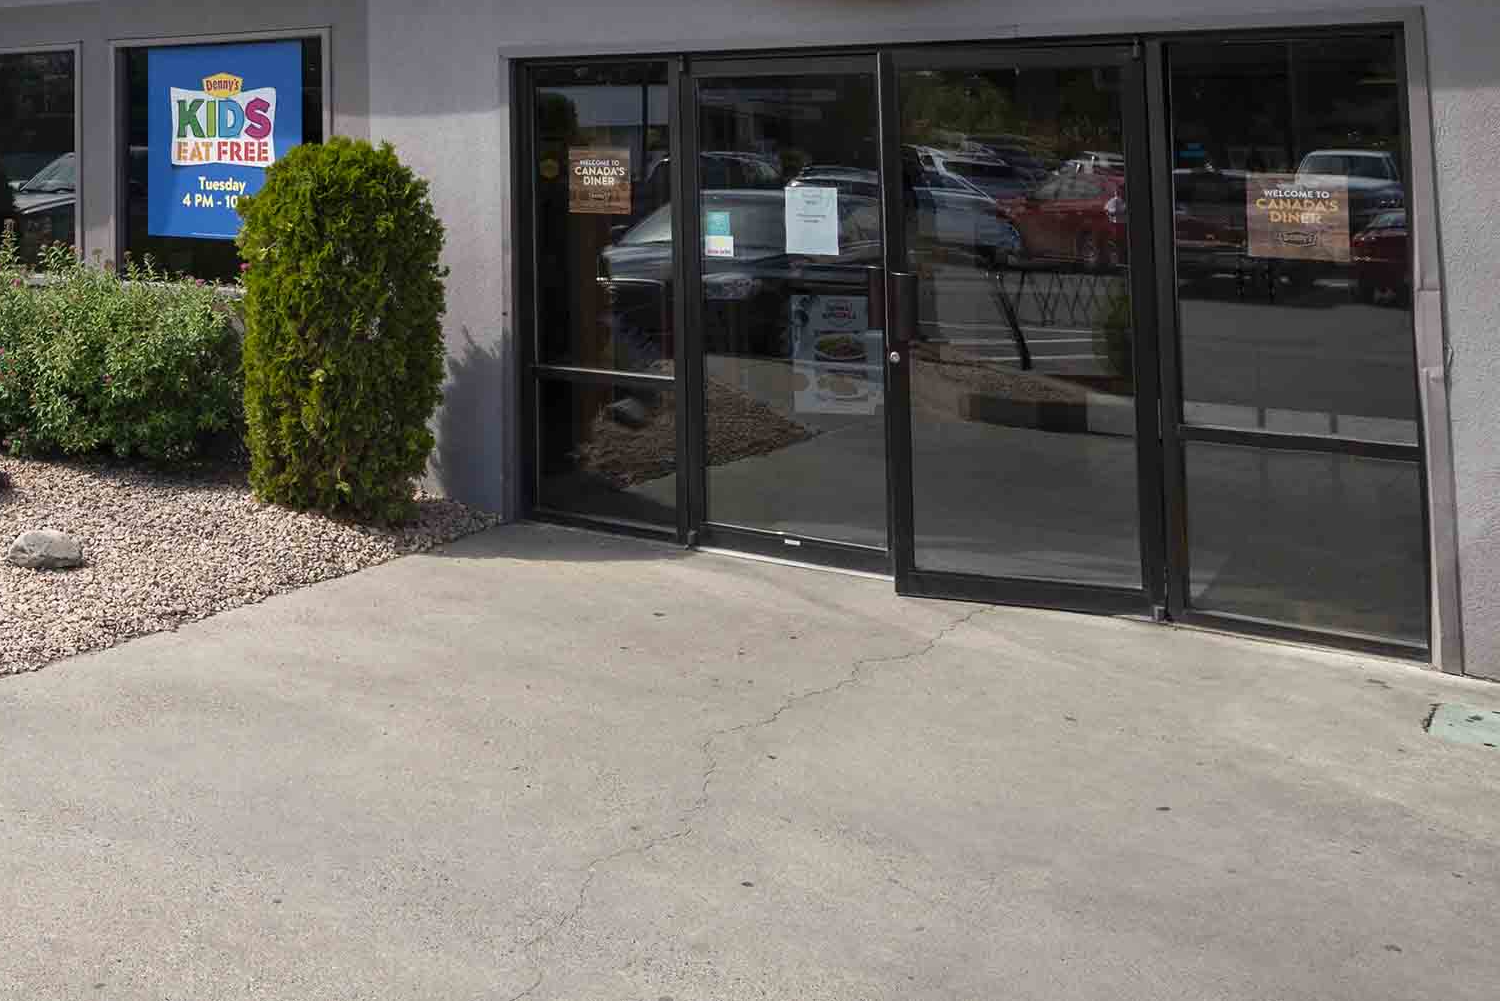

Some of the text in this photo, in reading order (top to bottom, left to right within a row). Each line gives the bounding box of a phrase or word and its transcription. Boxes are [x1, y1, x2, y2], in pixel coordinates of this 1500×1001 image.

[205, 78, 240, 92] Denny's
[176, 97, 272, 139] KIDS
[176, 141, 269, 162] EAT FREE
[580, 159, 620, 167] WELCOME TO
[574, 166, 626, 176] CANADA'S
[198, 176, 247, 194] Tuesday
[583, 176, 615, 186] DINER
[182, 194, 192, 208] 4
[195, 194, 214, 208] PM
[1264, 190, 1330, 199] WELCOME TO
[1256, 198, 1340, 212] CANADA'S
[1269, 211, 1323, 224] DINER
